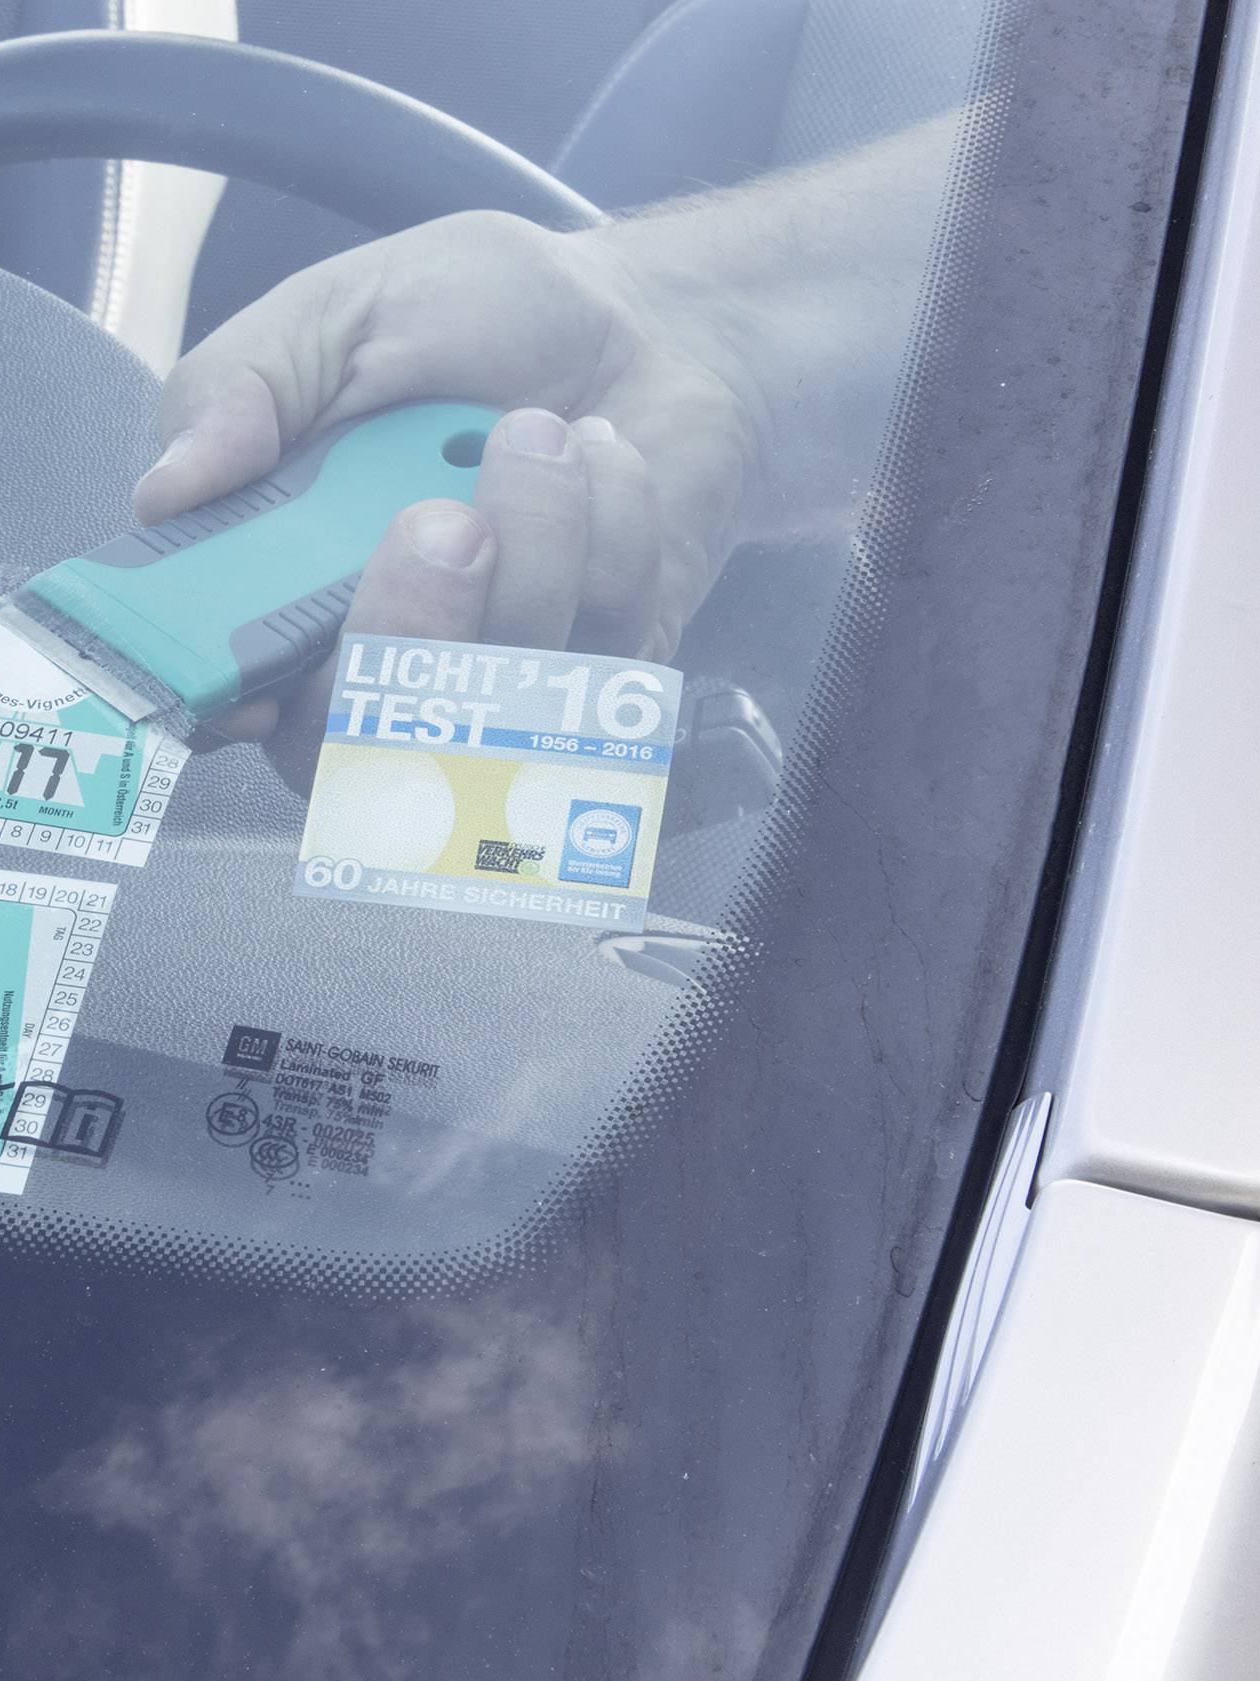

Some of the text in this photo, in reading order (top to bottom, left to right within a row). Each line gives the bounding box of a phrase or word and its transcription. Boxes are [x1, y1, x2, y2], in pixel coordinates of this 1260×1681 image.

[346, 644, 510, 696] LICHT
[341, 690, 501, 748] TEST
[530, 734, 580, 752] 1956
[602, 742, 654, 760] 2016
[156, 756, 180, 769] 28
[7, 743, 70, 800] 17
[148, 775, 171, 790] 29
[38, 806, 74, 818] MONTH
[140, 798, 162, 814] 30
[130, 820, 151, 836] 31
[10, 825, 23, 838] 8
[40, 830, 52, 842] 9
[68, 834, 86, 848] 10
[97, 839, 113, 853] 11
[0, 883, 18, 896] 18
[28, 886, 48, 900] 19
[54, 890, 78, 904] 20
[86, 894, 107, 908] 21
[304, 856, 627, 921] 60 JAHRE SICHERHEIT
[78, 918, 102, 932] 22
[53, 926, 68, 942] TAG
[70, 942, 94, 956] 23
[62, 966, 86, 981] 24
[54, 990, 79, 1006] 25
[22, 1022, 36, 1039] DAY
[46, 1016, 71, 1032] 26
[38, 1042, 62, 1057] 27
[238, 1036, 268, 1054] GM
[285, 1038, 441, 1078] SAINT-GOBAIN SEKURIT
[30, 1068, 54, 1082] 28
[280, 1059, 386, 1086] Laminated GF
[21, 1092, 46, 1108] 29
[14, 1118, 38, 1135] 30
[262, 1114, 297, 1130] 43R
[6, 1143, 28, 1158] 31
